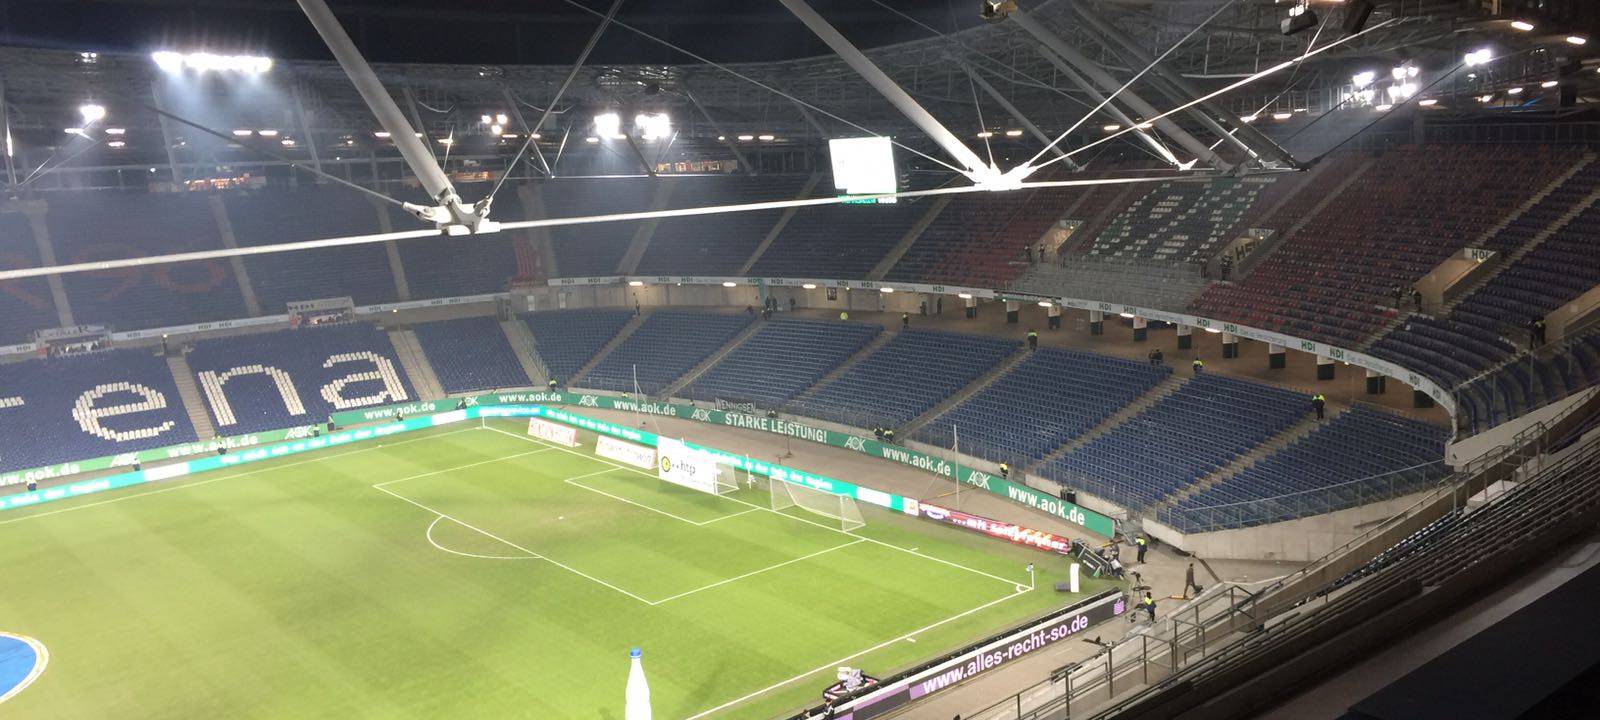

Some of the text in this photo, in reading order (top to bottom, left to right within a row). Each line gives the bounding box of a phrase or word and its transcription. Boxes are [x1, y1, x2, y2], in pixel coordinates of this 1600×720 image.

[1471, 249, 1489, 260] HDI
[1099, 302, 1137, 314] HDI HDI
[1196, 318, 1238, 333] HDI HDI
[1301, 340, 1344, 359] HDI HDI
[500, 391, 562, 404] www.aok.de
[284, 425, 313, 440] AOK
[578, 394, 1086, 526] AOK www.aok.de AOK STARKE LEISTUNG! AOK www.aok.de AOK www.aok.de
[923, 614, 1089, 694] www.alles-recht-so.de
